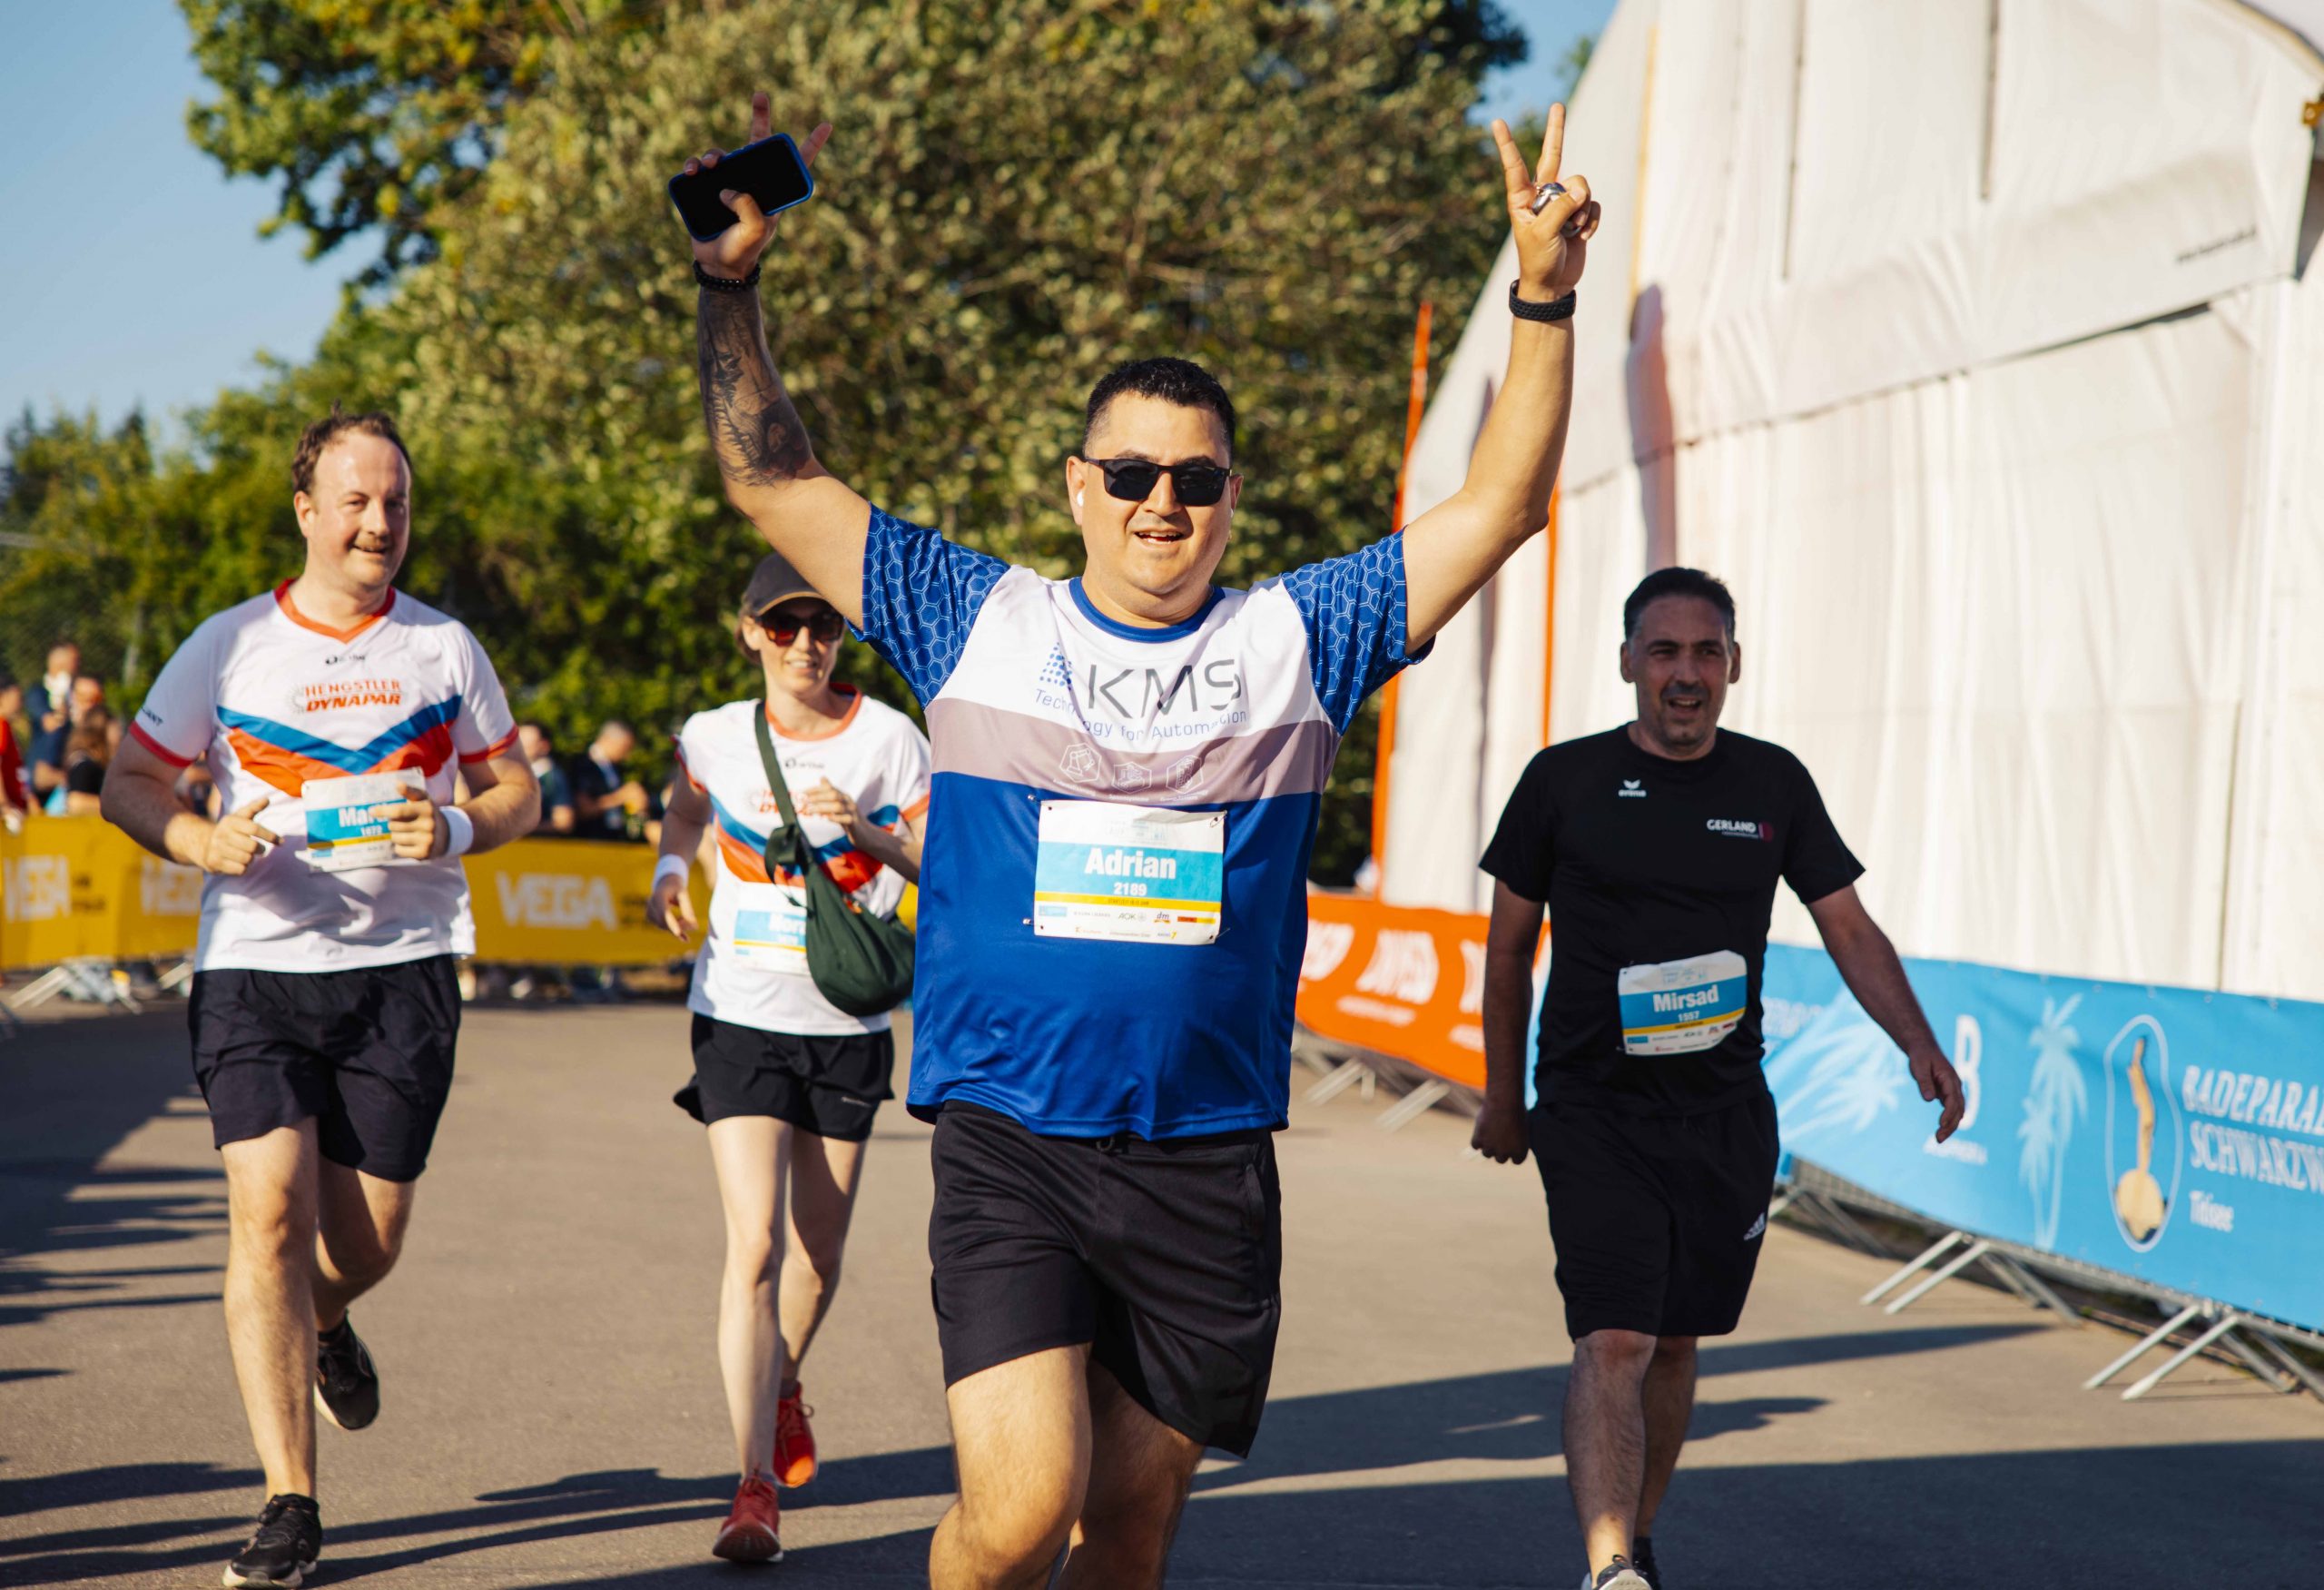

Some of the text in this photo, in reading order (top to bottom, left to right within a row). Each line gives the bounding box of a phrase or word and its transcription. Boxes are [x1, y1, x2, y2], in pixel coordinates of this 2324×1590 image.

[306, 679, 400, 697] HENGSTLER
[1088, 659, 1241, 719] KMS
[306, 693, 401, 711] DYNAPAR
[1120, 724, 1145, 741] for
[1707, 819, 1757, 834] GERLAND
[1085, 848, 1177, 879] Adrian
[1114, 883, 1147, 896] 2189
[496, 871, 619, 931] VEGA
[1157, 912, 1169, 920] dm
[1652, 984, 1719, 1012] Mirsad
